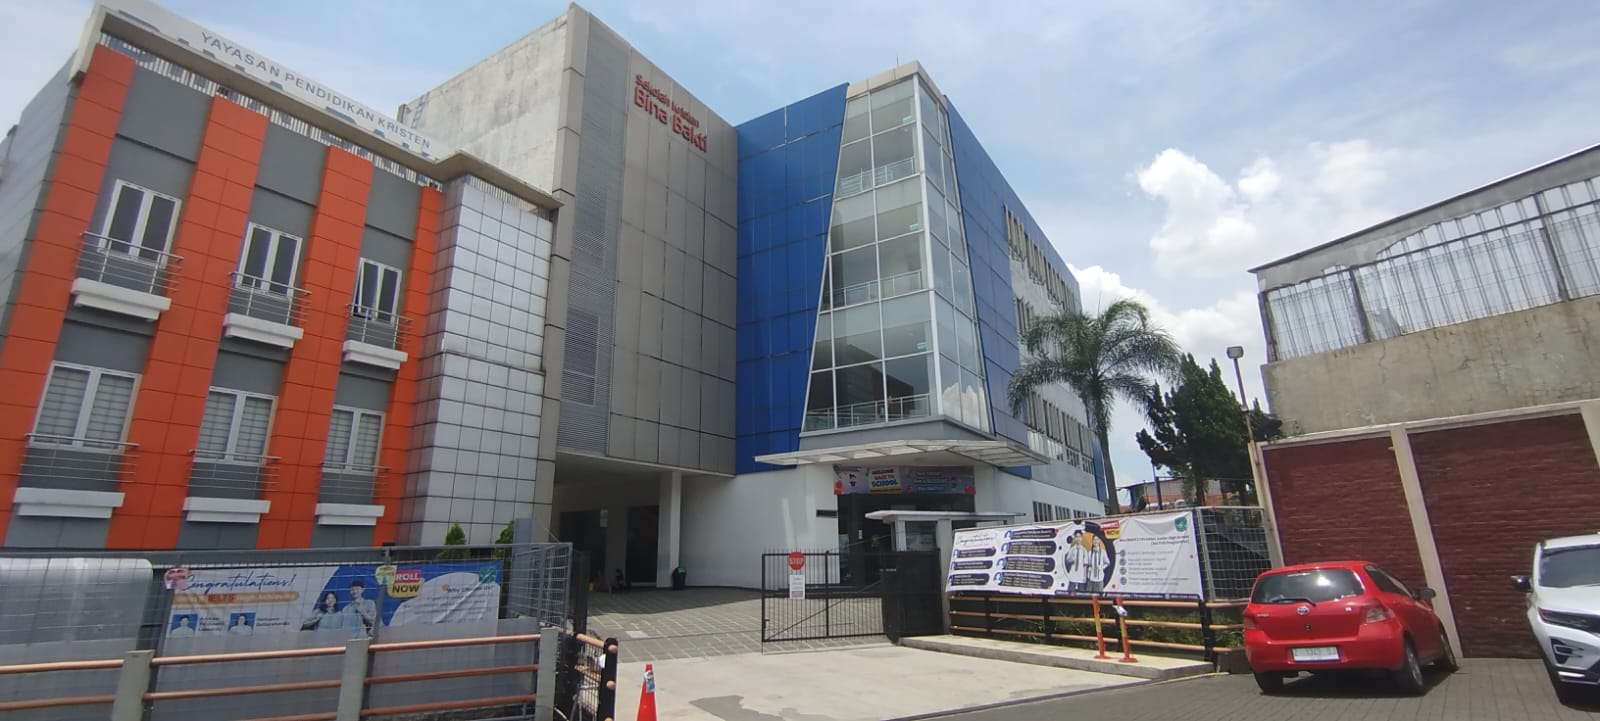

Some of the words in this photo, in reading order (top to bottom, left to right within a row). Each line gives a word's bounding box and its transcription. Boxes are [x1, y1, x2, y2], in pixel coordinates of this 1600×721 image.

[201, 31, 281, 77] YAYASAN
[284, 73, 376, 123] PENDIDIKAN
[377, 117, 430, 149] KRISTEN
[634, 86, 668, 125] Bina
[672, 114, 708, 153] Bakti
[871, 479, 898, 488] SCHOOL
[788, 557, 804, 565] STOP
[182, 571, 297, 594] Congratulations!
[391, 582, 420, 593] NOW
